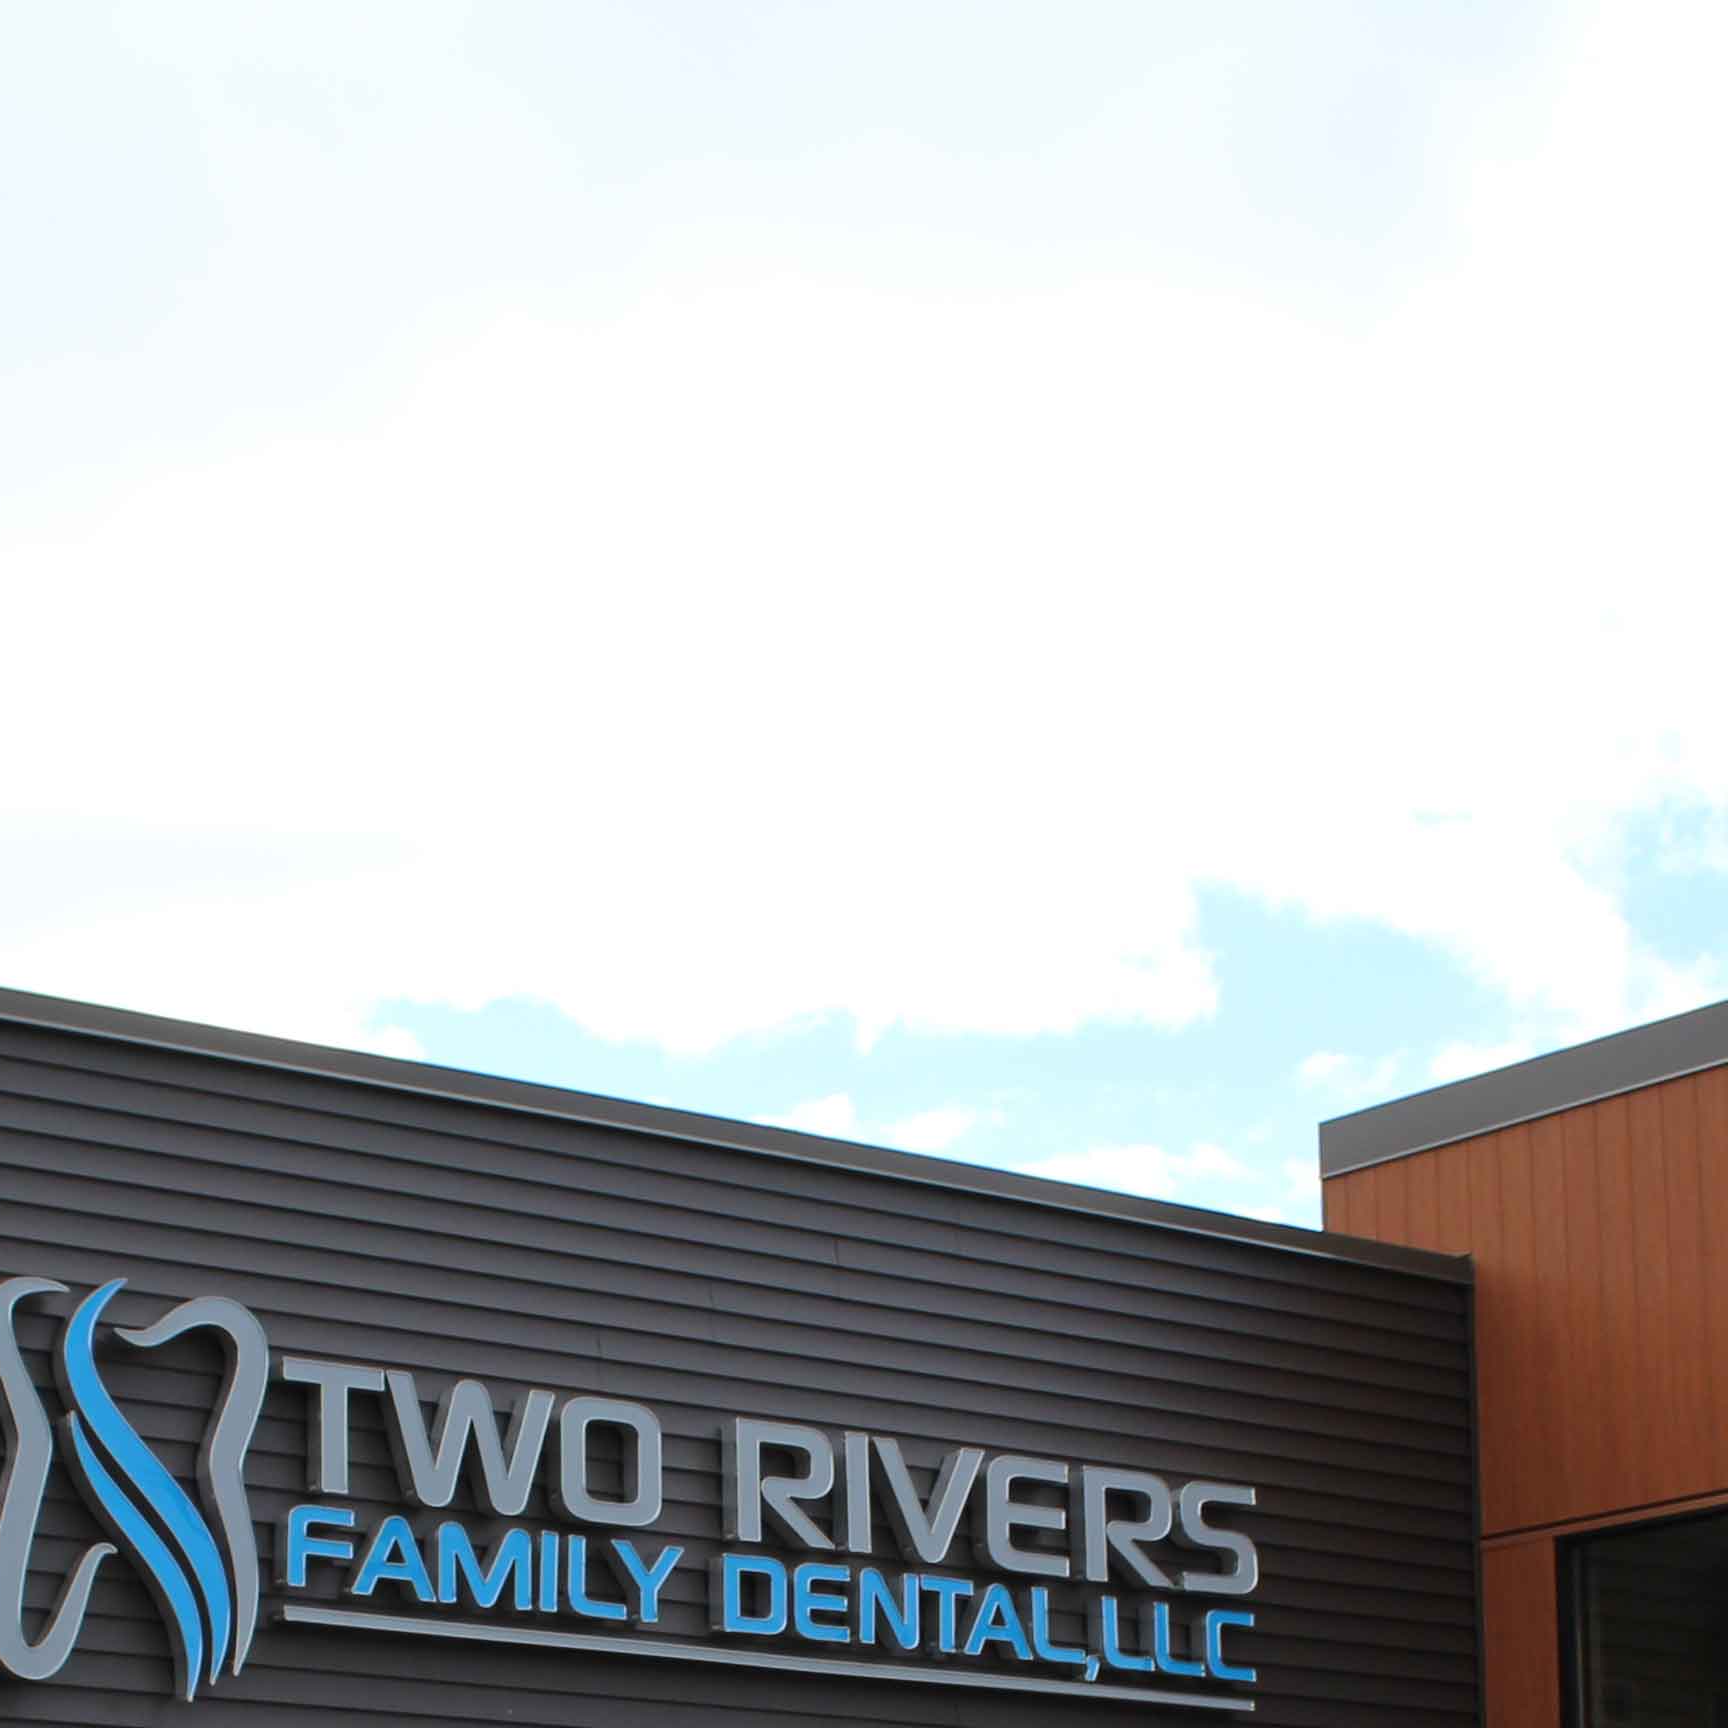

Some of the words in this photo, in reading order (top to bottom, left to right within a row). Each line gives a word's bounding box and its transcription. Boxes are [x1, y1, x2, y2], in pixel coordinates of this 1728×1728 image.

[281, 1355, 664, 1528] TWO
[730, 1415, 1260, 1597] RIVERS
[285, 1504, 686, 1624] FAMILY
